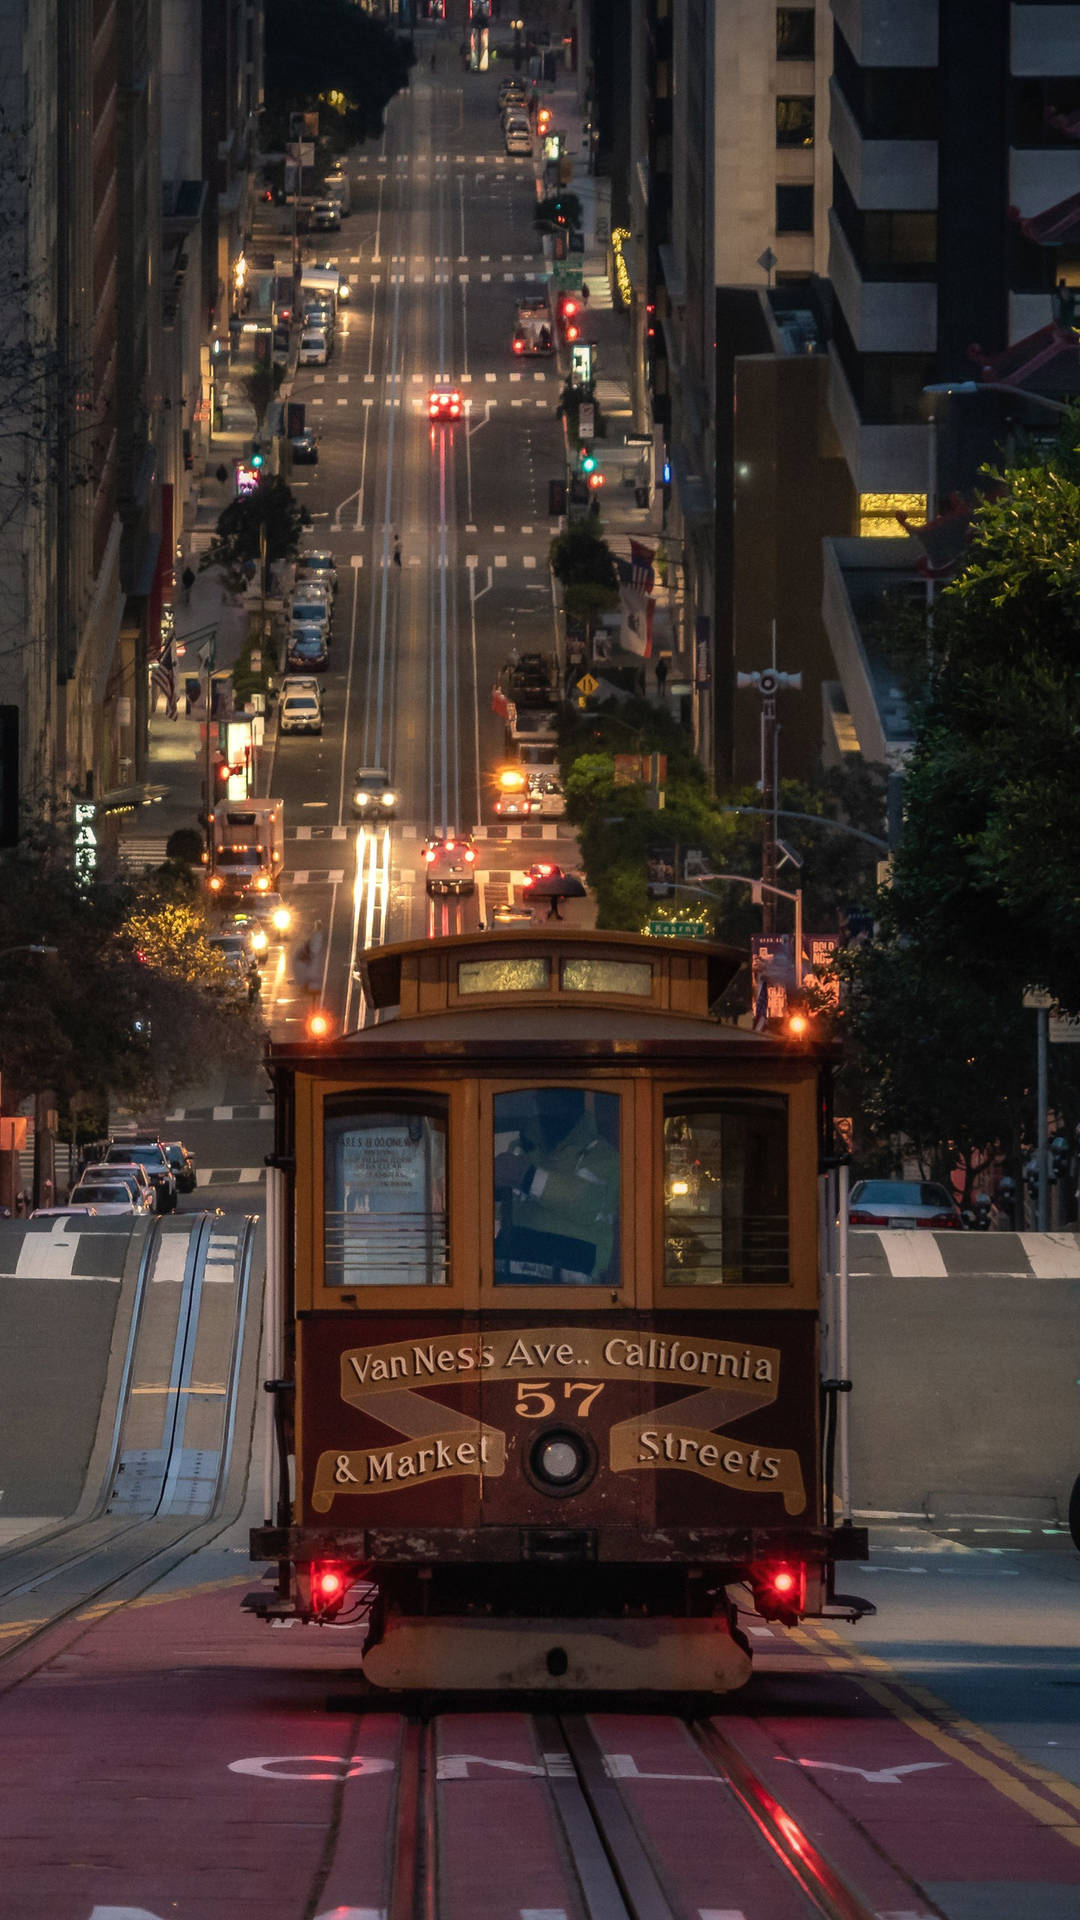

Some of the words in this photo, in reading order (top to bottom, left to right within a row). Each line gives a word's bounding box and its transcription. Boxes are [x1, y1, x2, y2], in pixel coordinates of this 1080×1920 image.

[350, 1353, 409, 1384] Van
[412, 1345, 496, 1376] Ness
[605, 1338, 773, 1382] California
[514, 1382, 605, 1419] 57
[335, 1455, 359, 1483] &
[368, 1435, 490, 1483] Market
[639, 1431, 782, 1479] Streets
[227, 1753, 953, 1784] ONLY
